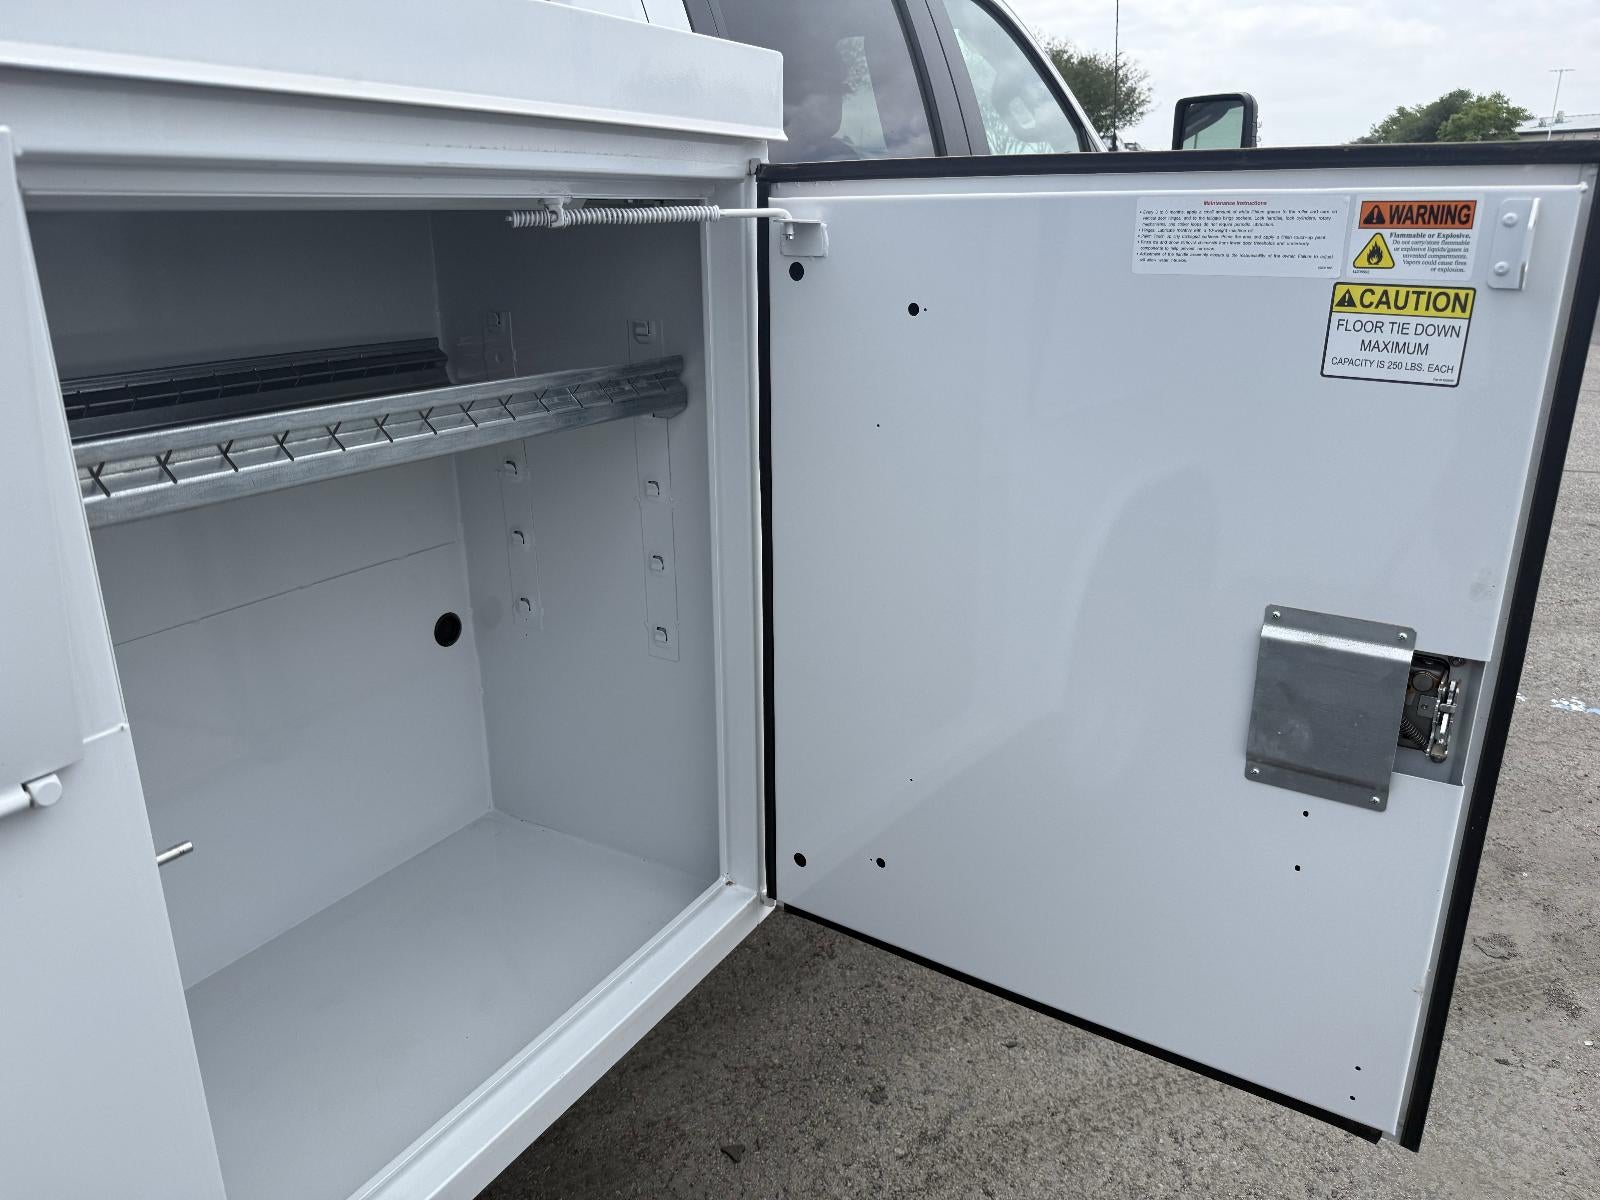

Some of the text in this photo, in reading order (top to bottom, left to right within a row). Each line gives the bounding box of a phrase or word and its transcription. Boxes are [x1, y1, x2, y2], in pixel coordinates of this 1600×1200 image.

[1389, 204, 1471, 225] WARNING
[1359, 288, 1469, 313] CAUTION
[1336, 319, 1461, 338] FLOOR TIE DOWN
[1360, 340, 1429, 356] MAXIMUM
[1331, 357, 1454, 374] CAPACITY IS 250 LBS. EACH
